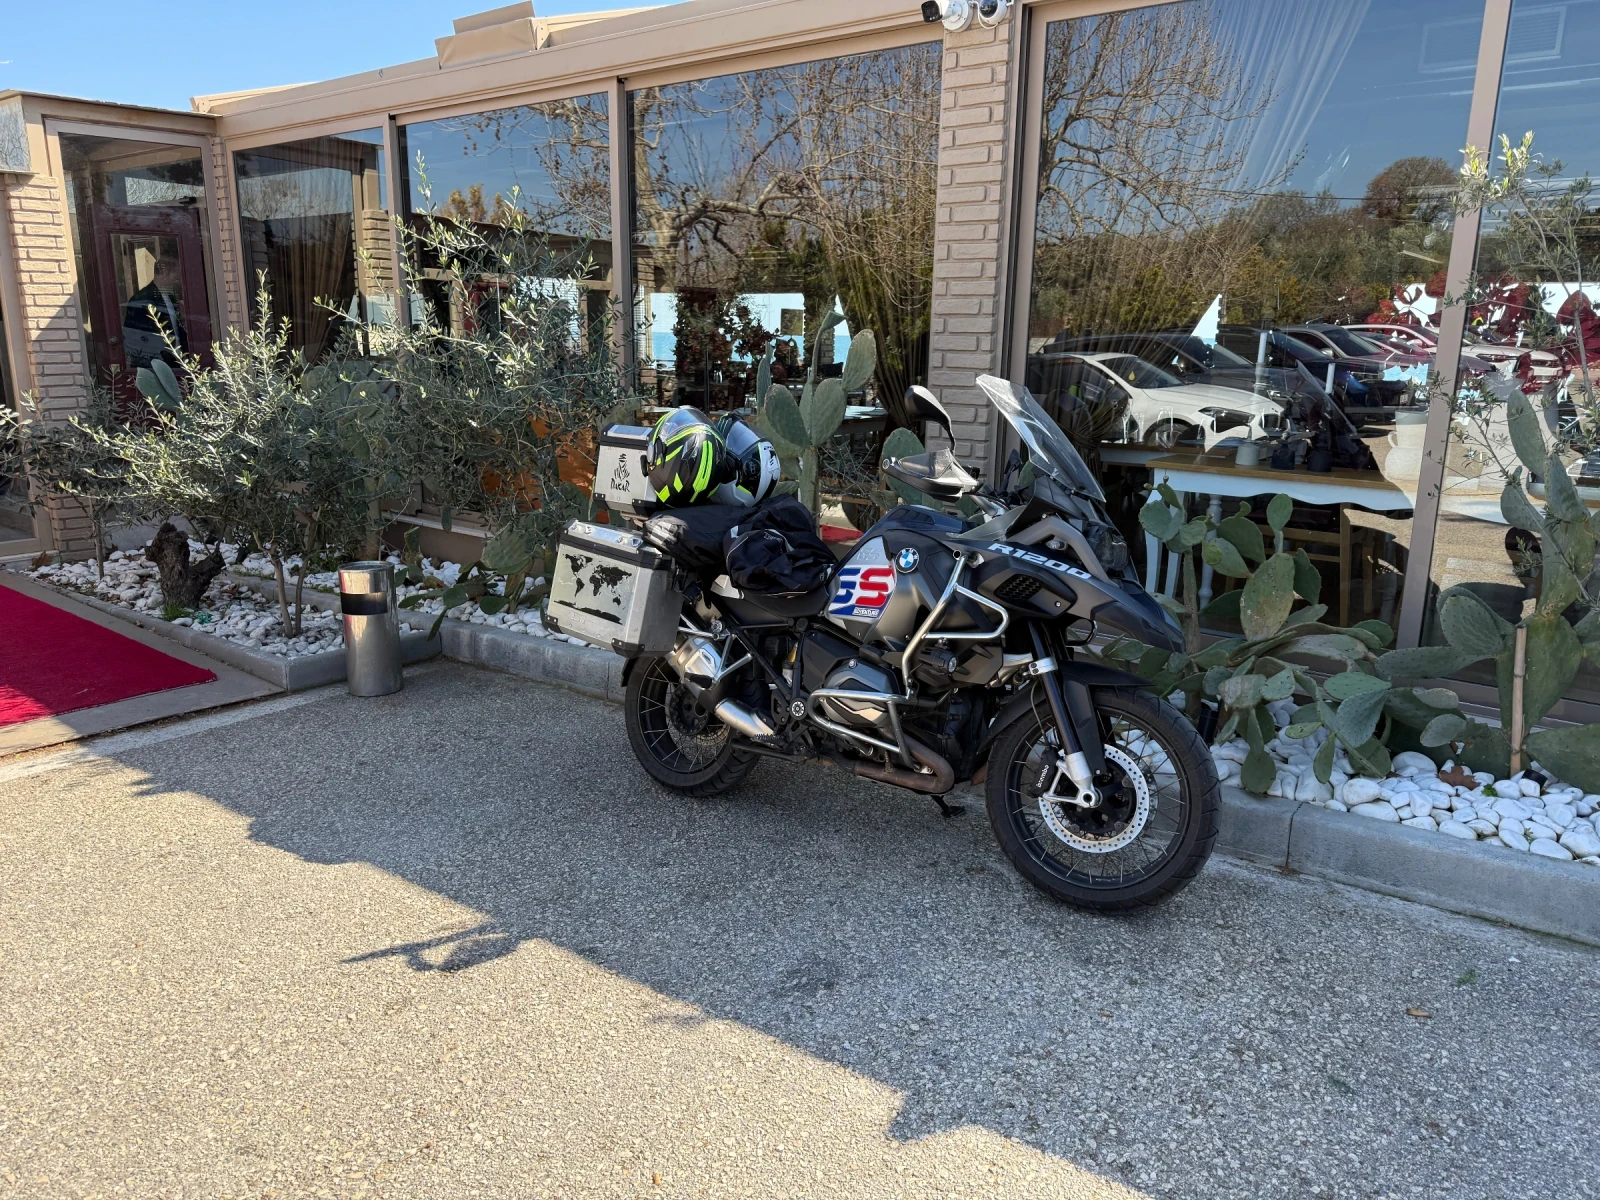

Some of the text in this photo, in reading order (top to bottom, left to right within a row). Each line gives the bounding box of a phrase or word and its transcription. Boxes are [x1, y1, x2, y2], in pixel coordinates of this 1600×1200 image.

[610, 477, 630, 492] DAKAR
[988, 543, 1092, 579] R1200
[1035, 764, 1050, 788] brembo
